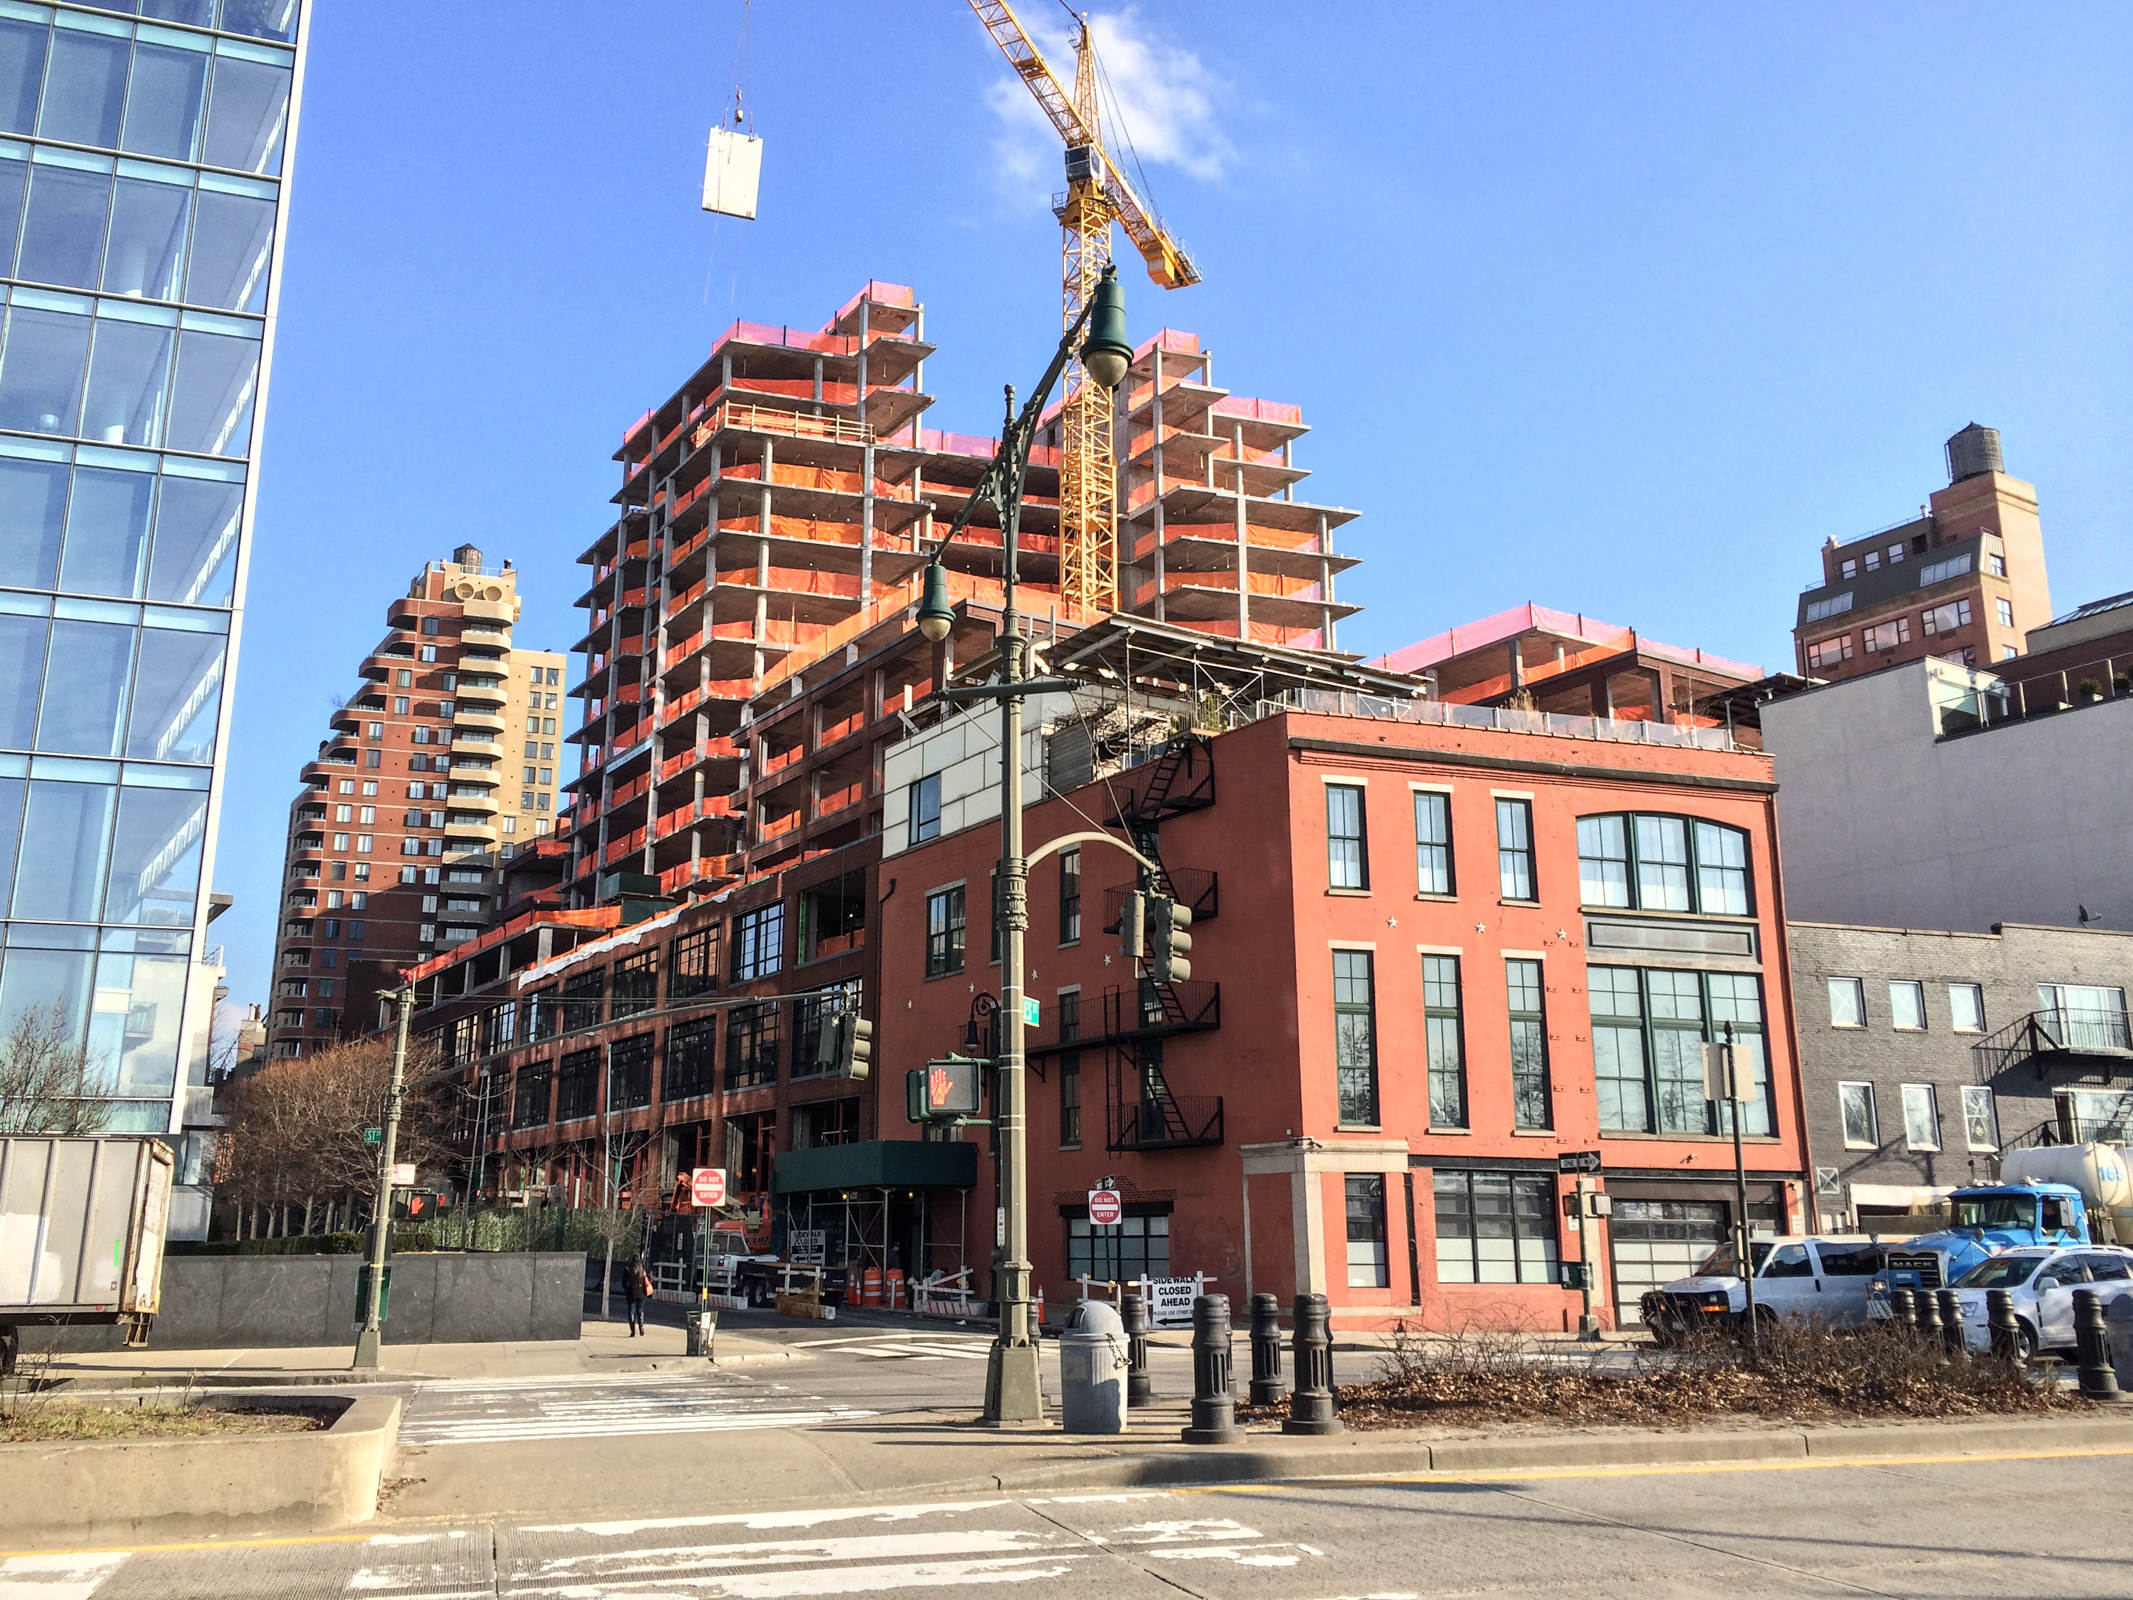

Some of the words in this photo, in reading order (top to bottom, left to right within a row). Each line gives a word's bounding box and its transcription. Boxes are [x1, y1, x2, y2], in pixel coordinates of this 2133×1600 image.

[1563, 1159, 1575, 1167] ONE
[1152, 1276, 1197, 1285] SIDEWALK
[1158, 1286, 1192, 1296] CLOSED
[1160, 1297, 1191, 1307] AHEAD
